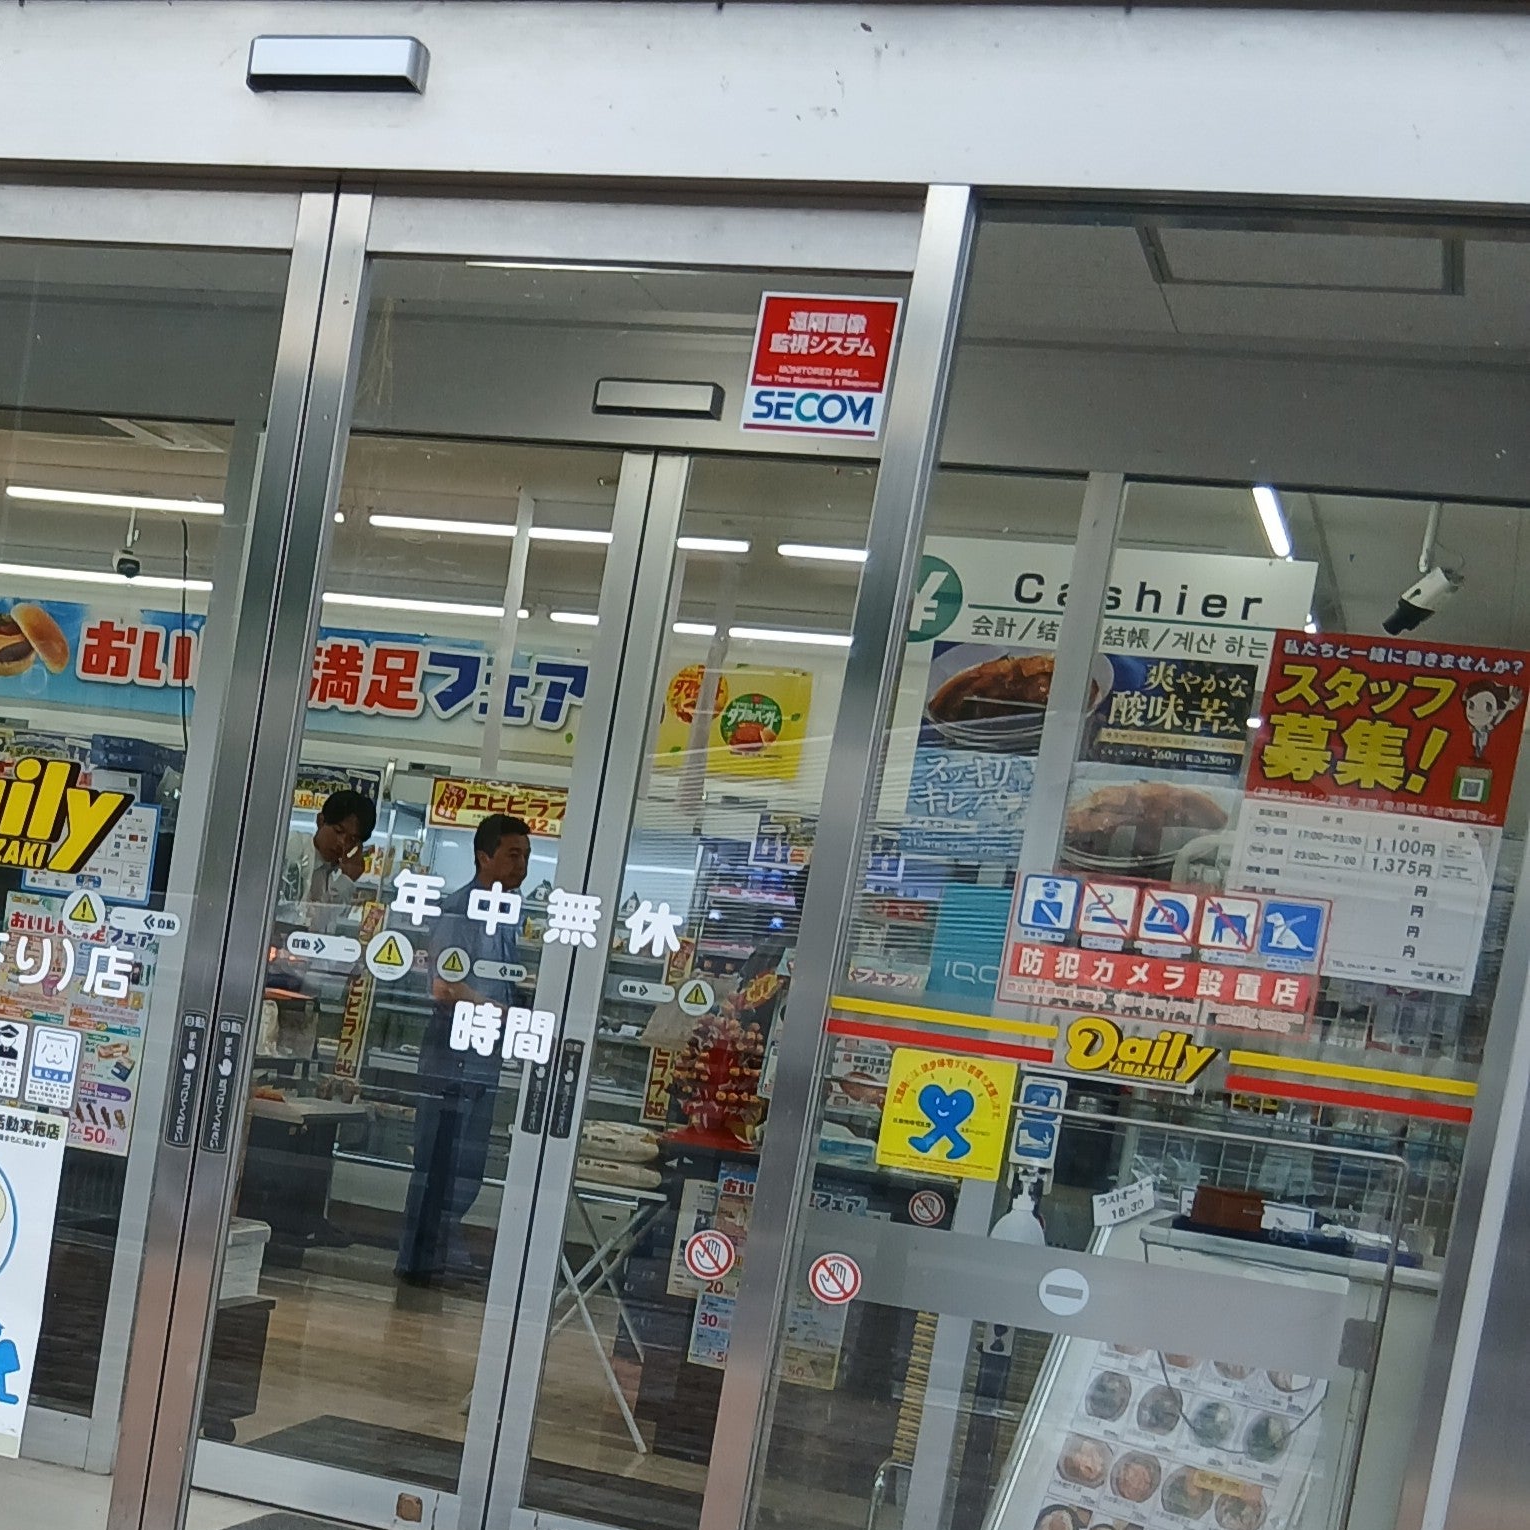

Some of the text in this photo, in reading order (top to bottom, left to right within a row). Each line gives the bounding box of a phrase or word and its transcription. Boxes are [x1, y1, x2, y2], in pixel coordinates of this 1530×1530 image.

[769, 333, 876, 358] 監視システム
[752, 390, 875, 426] SECOM
[1143, 660, 1248, 698] 爽やかな
[1275, 664, 1458, 719] スタッフ
[1108, 690, 1241, 734] 酸味と苦み
[1261, 711, 1449, 795] 募集!
[1410, 904, 1424, 918] 円
[1413, 885, 1428, 898] 円
[390, 867, 684, 958] 年中無休
[1406, 925, 1420, 939] 円
[1402, 944, 1416, 959] 円
[1017, 947, 1300, 1008] 防犯カメラ設置店
[448, 999, 557, 1064] 時間
[1065, 1016, 1222, 1084] Daily
